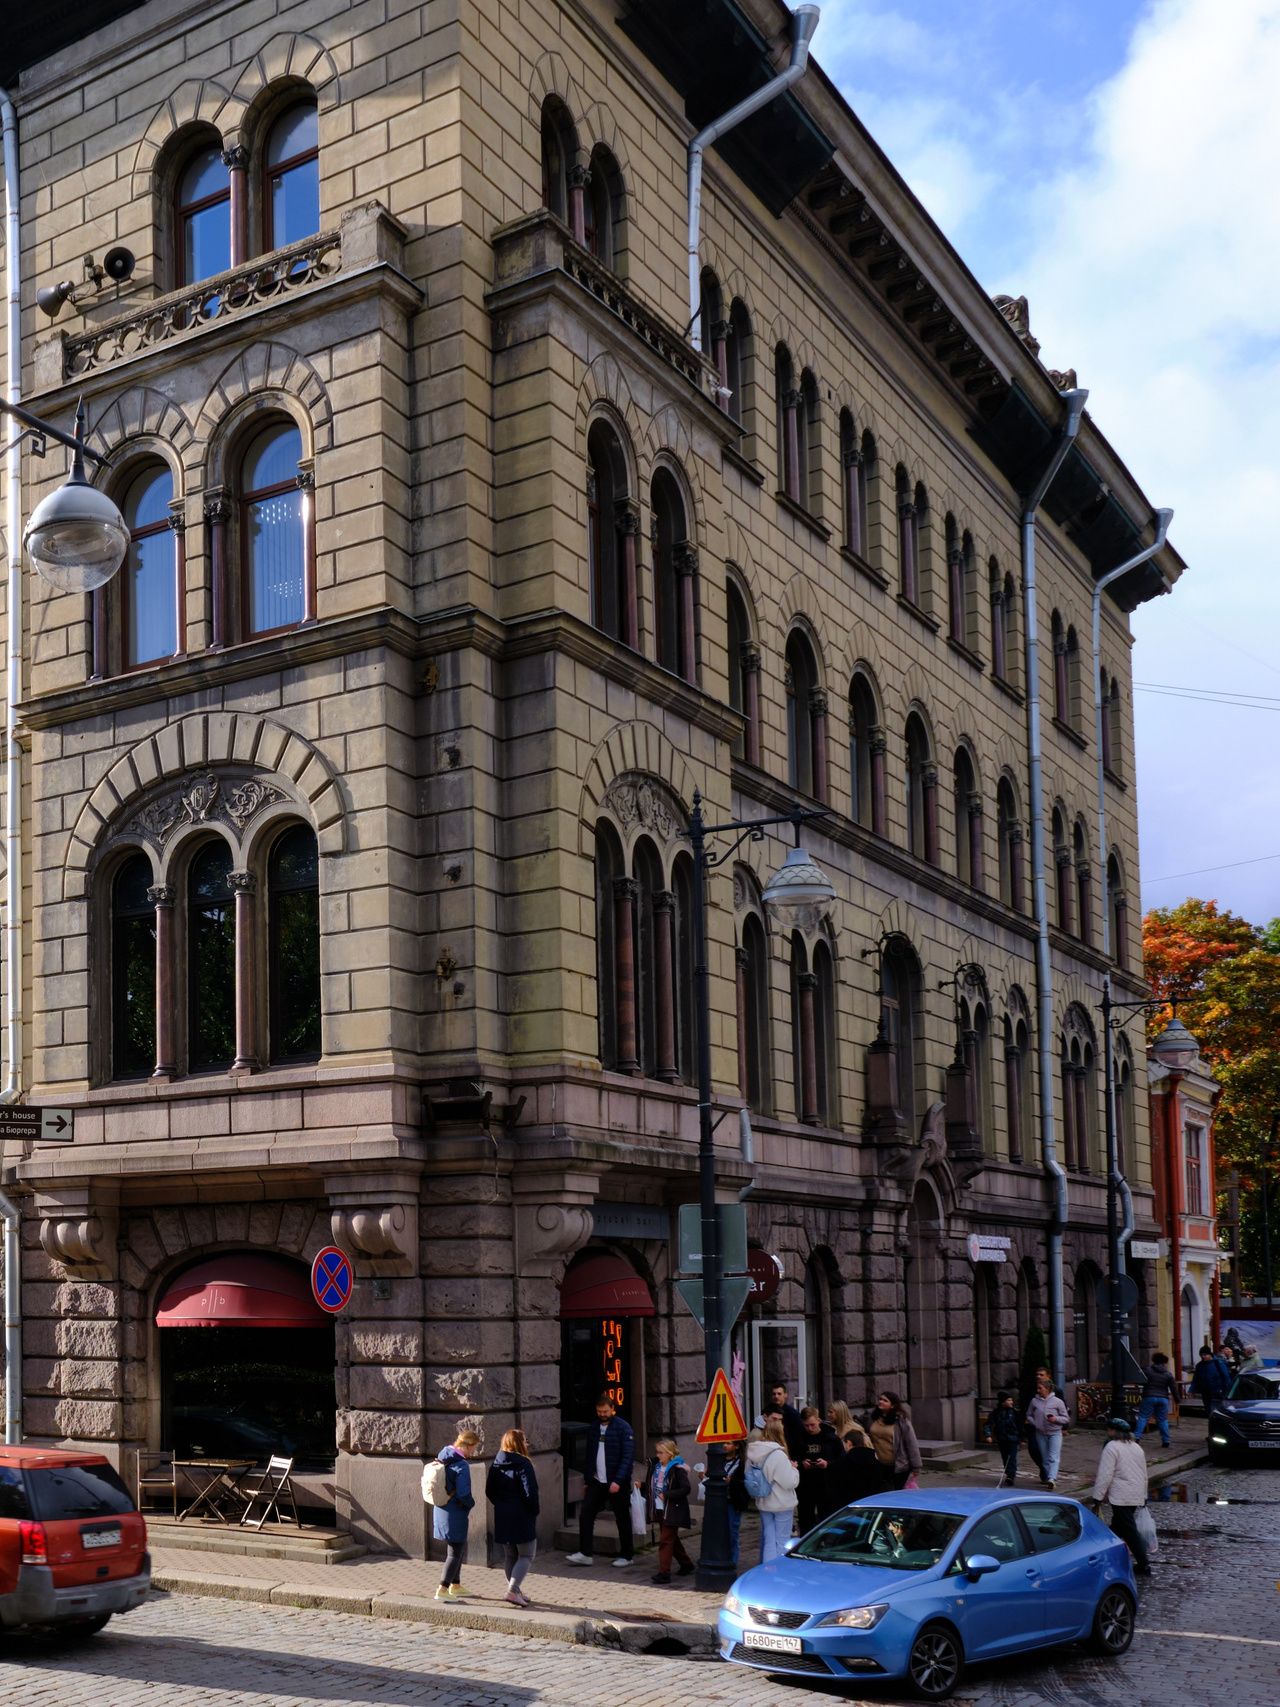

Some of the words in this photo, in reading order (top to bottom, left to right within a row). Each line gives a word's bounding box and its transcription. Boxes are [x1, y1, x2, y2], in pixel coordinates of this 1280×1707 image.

[12, 1111, 36, 1119] house
[6, 1126, 36, 1135] Бюргера
[749, 1281, 766, 1292] ar
[746, 1634, 782, 1649] В680РЕ
[783, 1637, 798, 1648] 147
